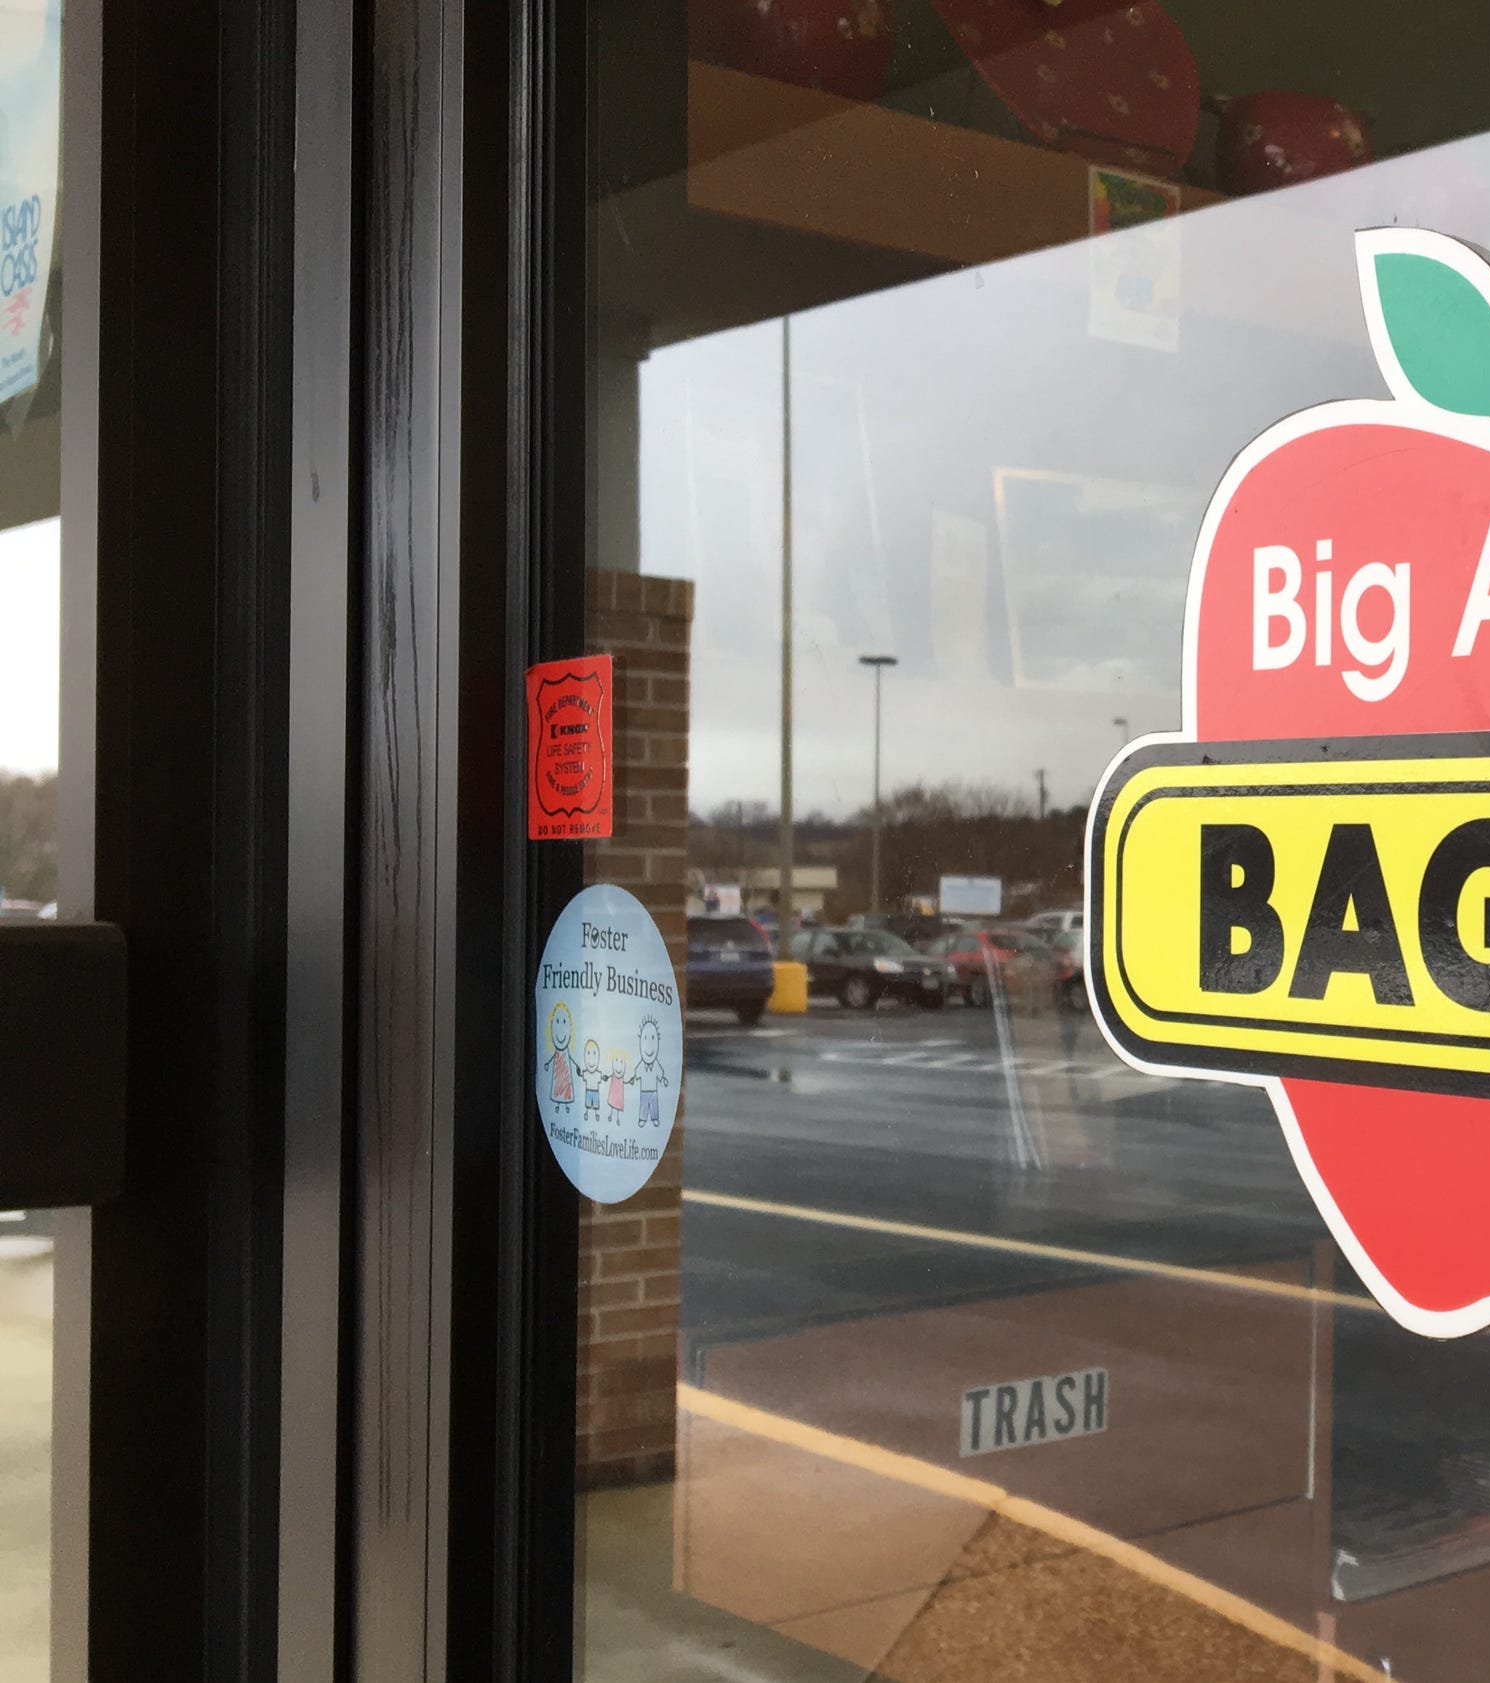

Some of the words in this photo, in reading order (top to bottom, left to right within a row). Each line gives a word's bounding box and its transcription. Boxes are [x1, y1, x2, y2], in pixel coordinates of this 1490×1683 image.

[1252, 538, 1412, 702] Big
[560, 724, 588, 736] KNOX
[547, 744, 562, 758] LIFE
[564, 742, 592, 756] SAFETY
[555, 761, 585, 776] SYSTEM
[538, 824, 549, 836] DO
[551, 823, 566, 835] NOT
[569, 822, 601, 834] REMOVE
[581, 922, 629, 952] Foster
[542, 961, 603, 998] Friendly
[606, 965, 674, 1006] Business
[550, 1122, 659, 1161] FosterFamiliesLoveLife.com
[965, 1371, 1106, 1451] TRASH
